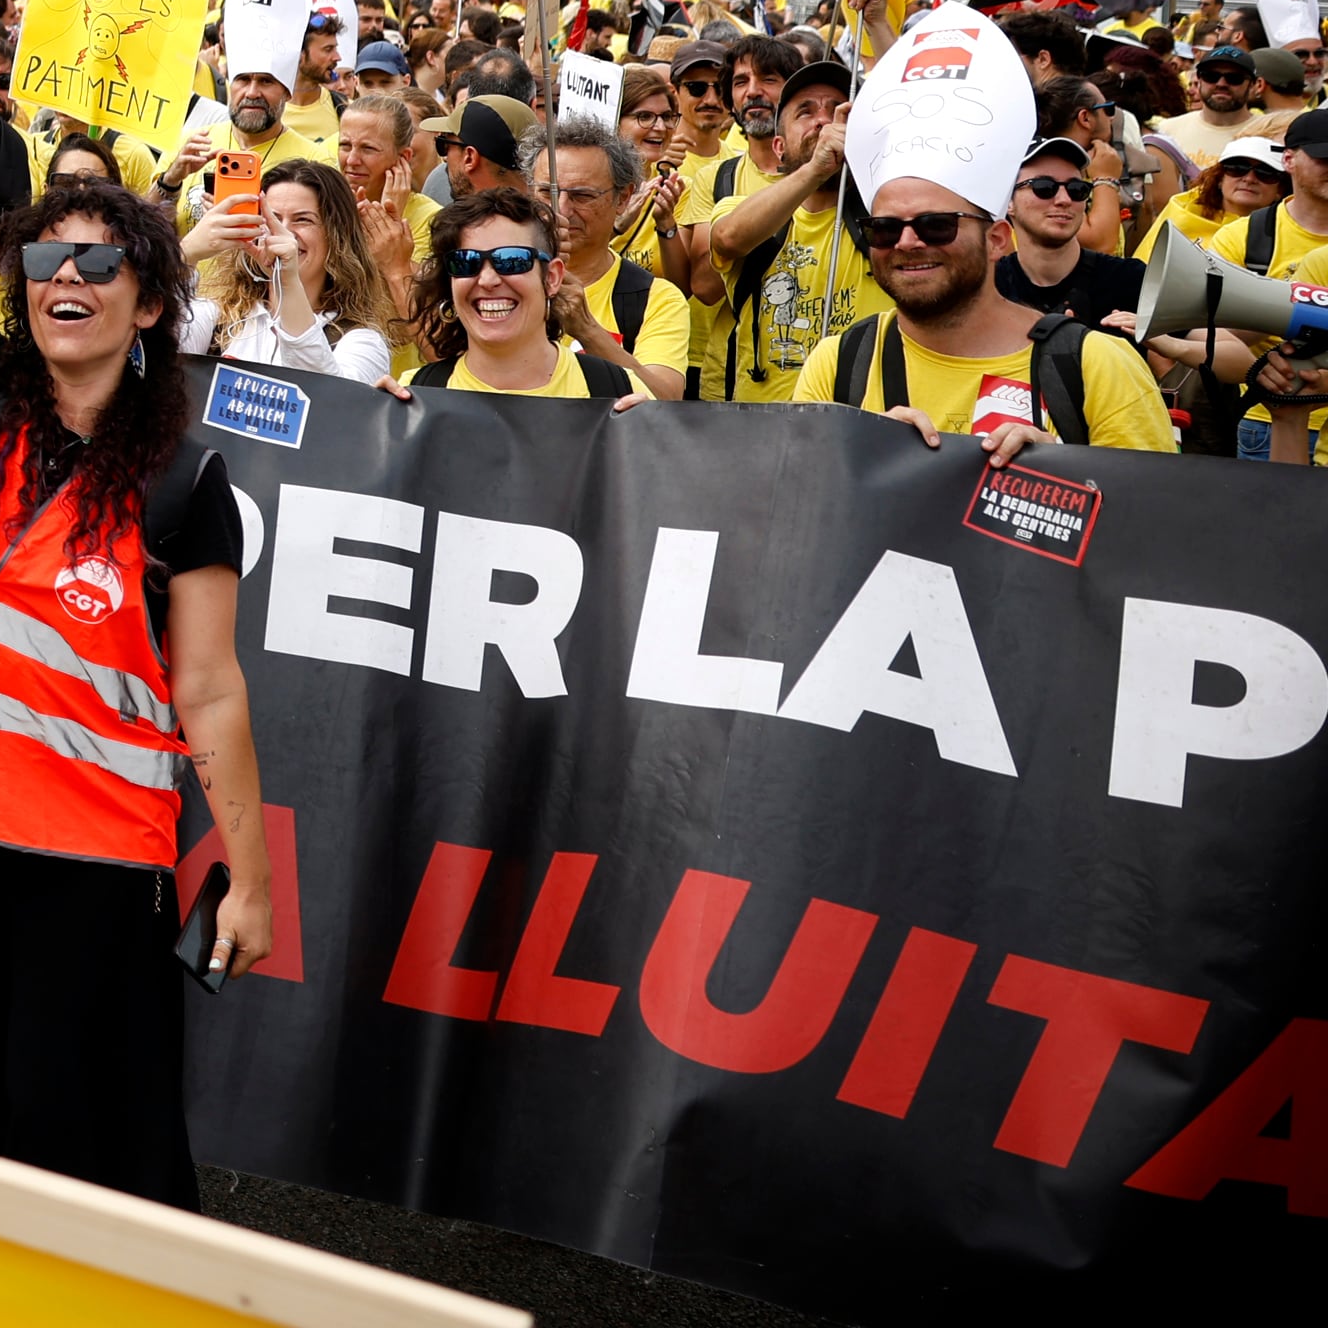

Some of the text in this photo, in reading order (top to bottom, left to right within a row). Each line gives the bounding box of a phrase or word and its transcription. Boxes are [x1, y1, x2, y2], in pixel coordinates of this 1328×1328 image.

[905, 65, 967, 81] CGT
[872, 87, 994, 135] SOS
[219, 384, 298, 414] ELS SALARIS
[234, 376, 289, 402] APUGEM
[218, 407, 240, 422] LES
[227, 399, 285, 424] ABAIXEM
[989, 471, 1087, 513] RECUPEREM
[980, 487, 1083, 532] LA DEMOCRÀCIA
[983, 504, 1072, 542] ALS CENTRES
[64, 588, 107, 617] CGT
[232, 484, 583, 699] ER
[627, 527, 1018, 777] LA
[1108, 597, 1328, 808] P
[383, 842, 1328, 1217] LLUITA
